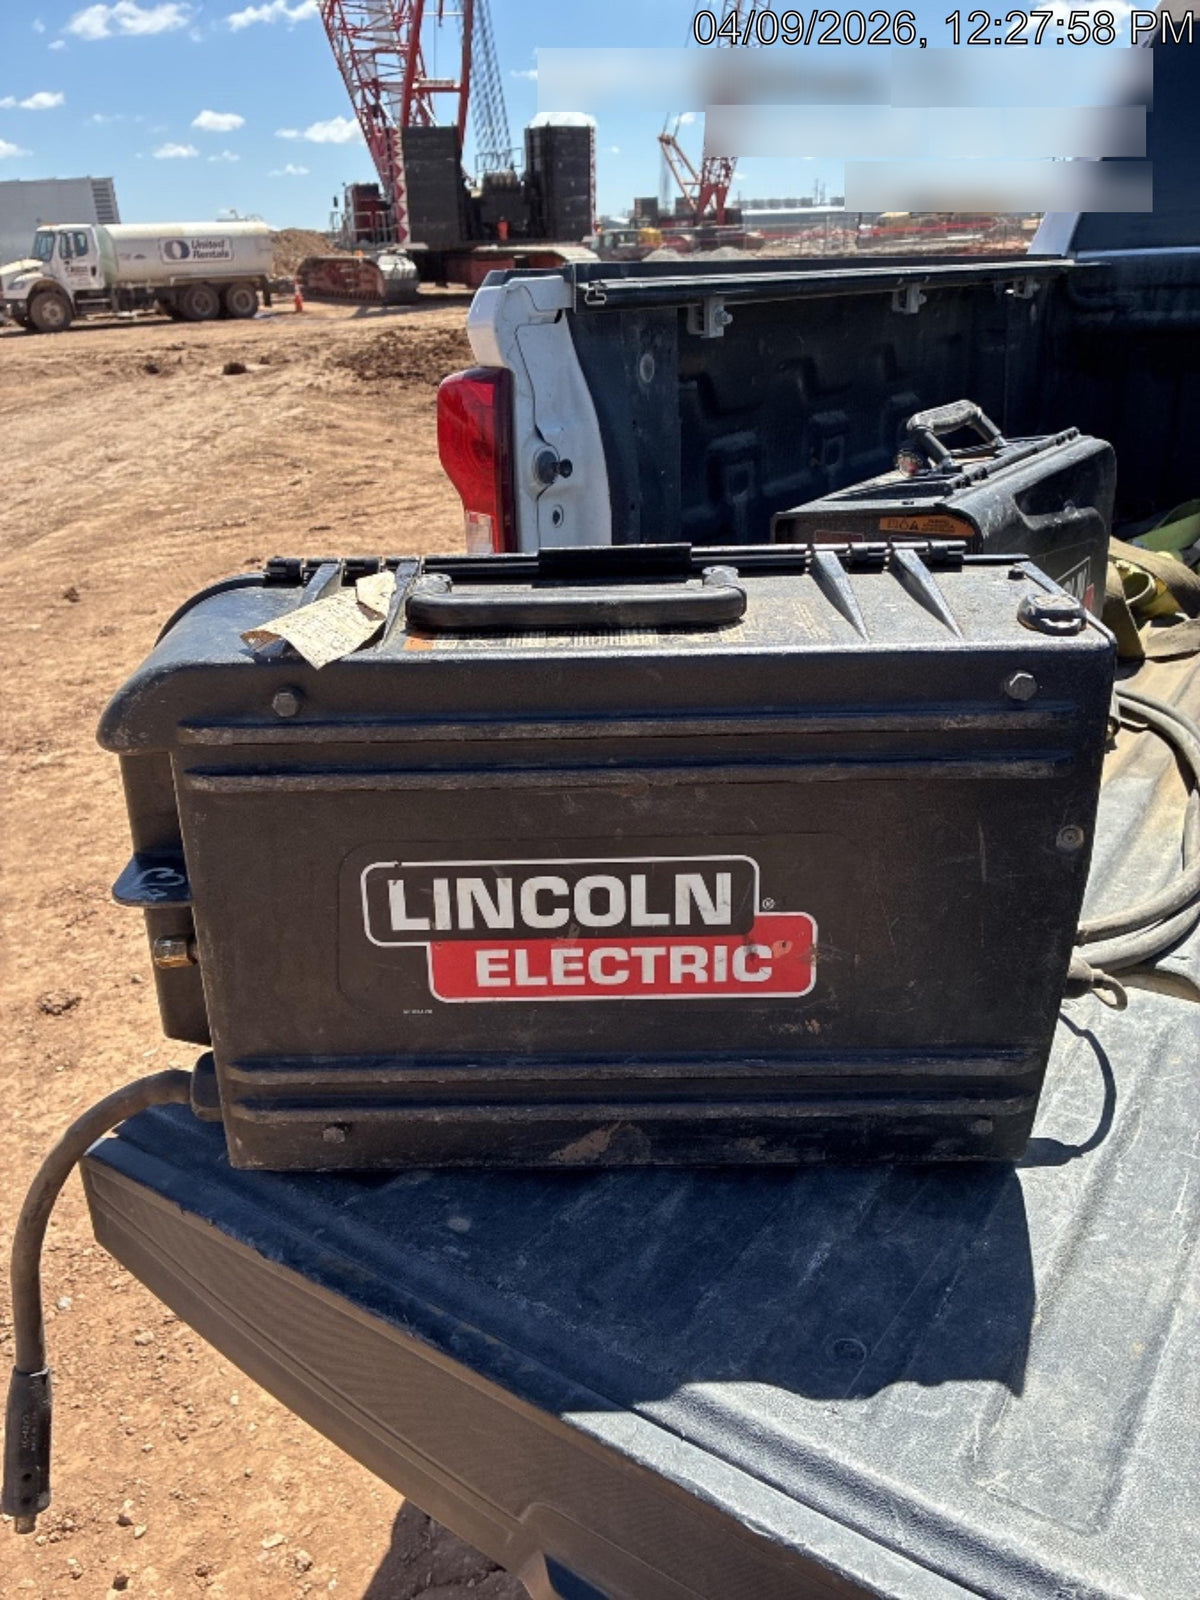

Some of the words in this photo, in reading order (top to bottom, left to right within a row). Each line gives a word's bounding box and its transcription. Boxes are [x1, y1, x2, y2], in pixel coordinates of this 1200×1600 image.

[191, 239, 225, 249] United
[193, 250, 230, 259] Rentals
[388, 871, 732, 931] LINCOLN
[475, 944, 774, 988] ELECTRIC
